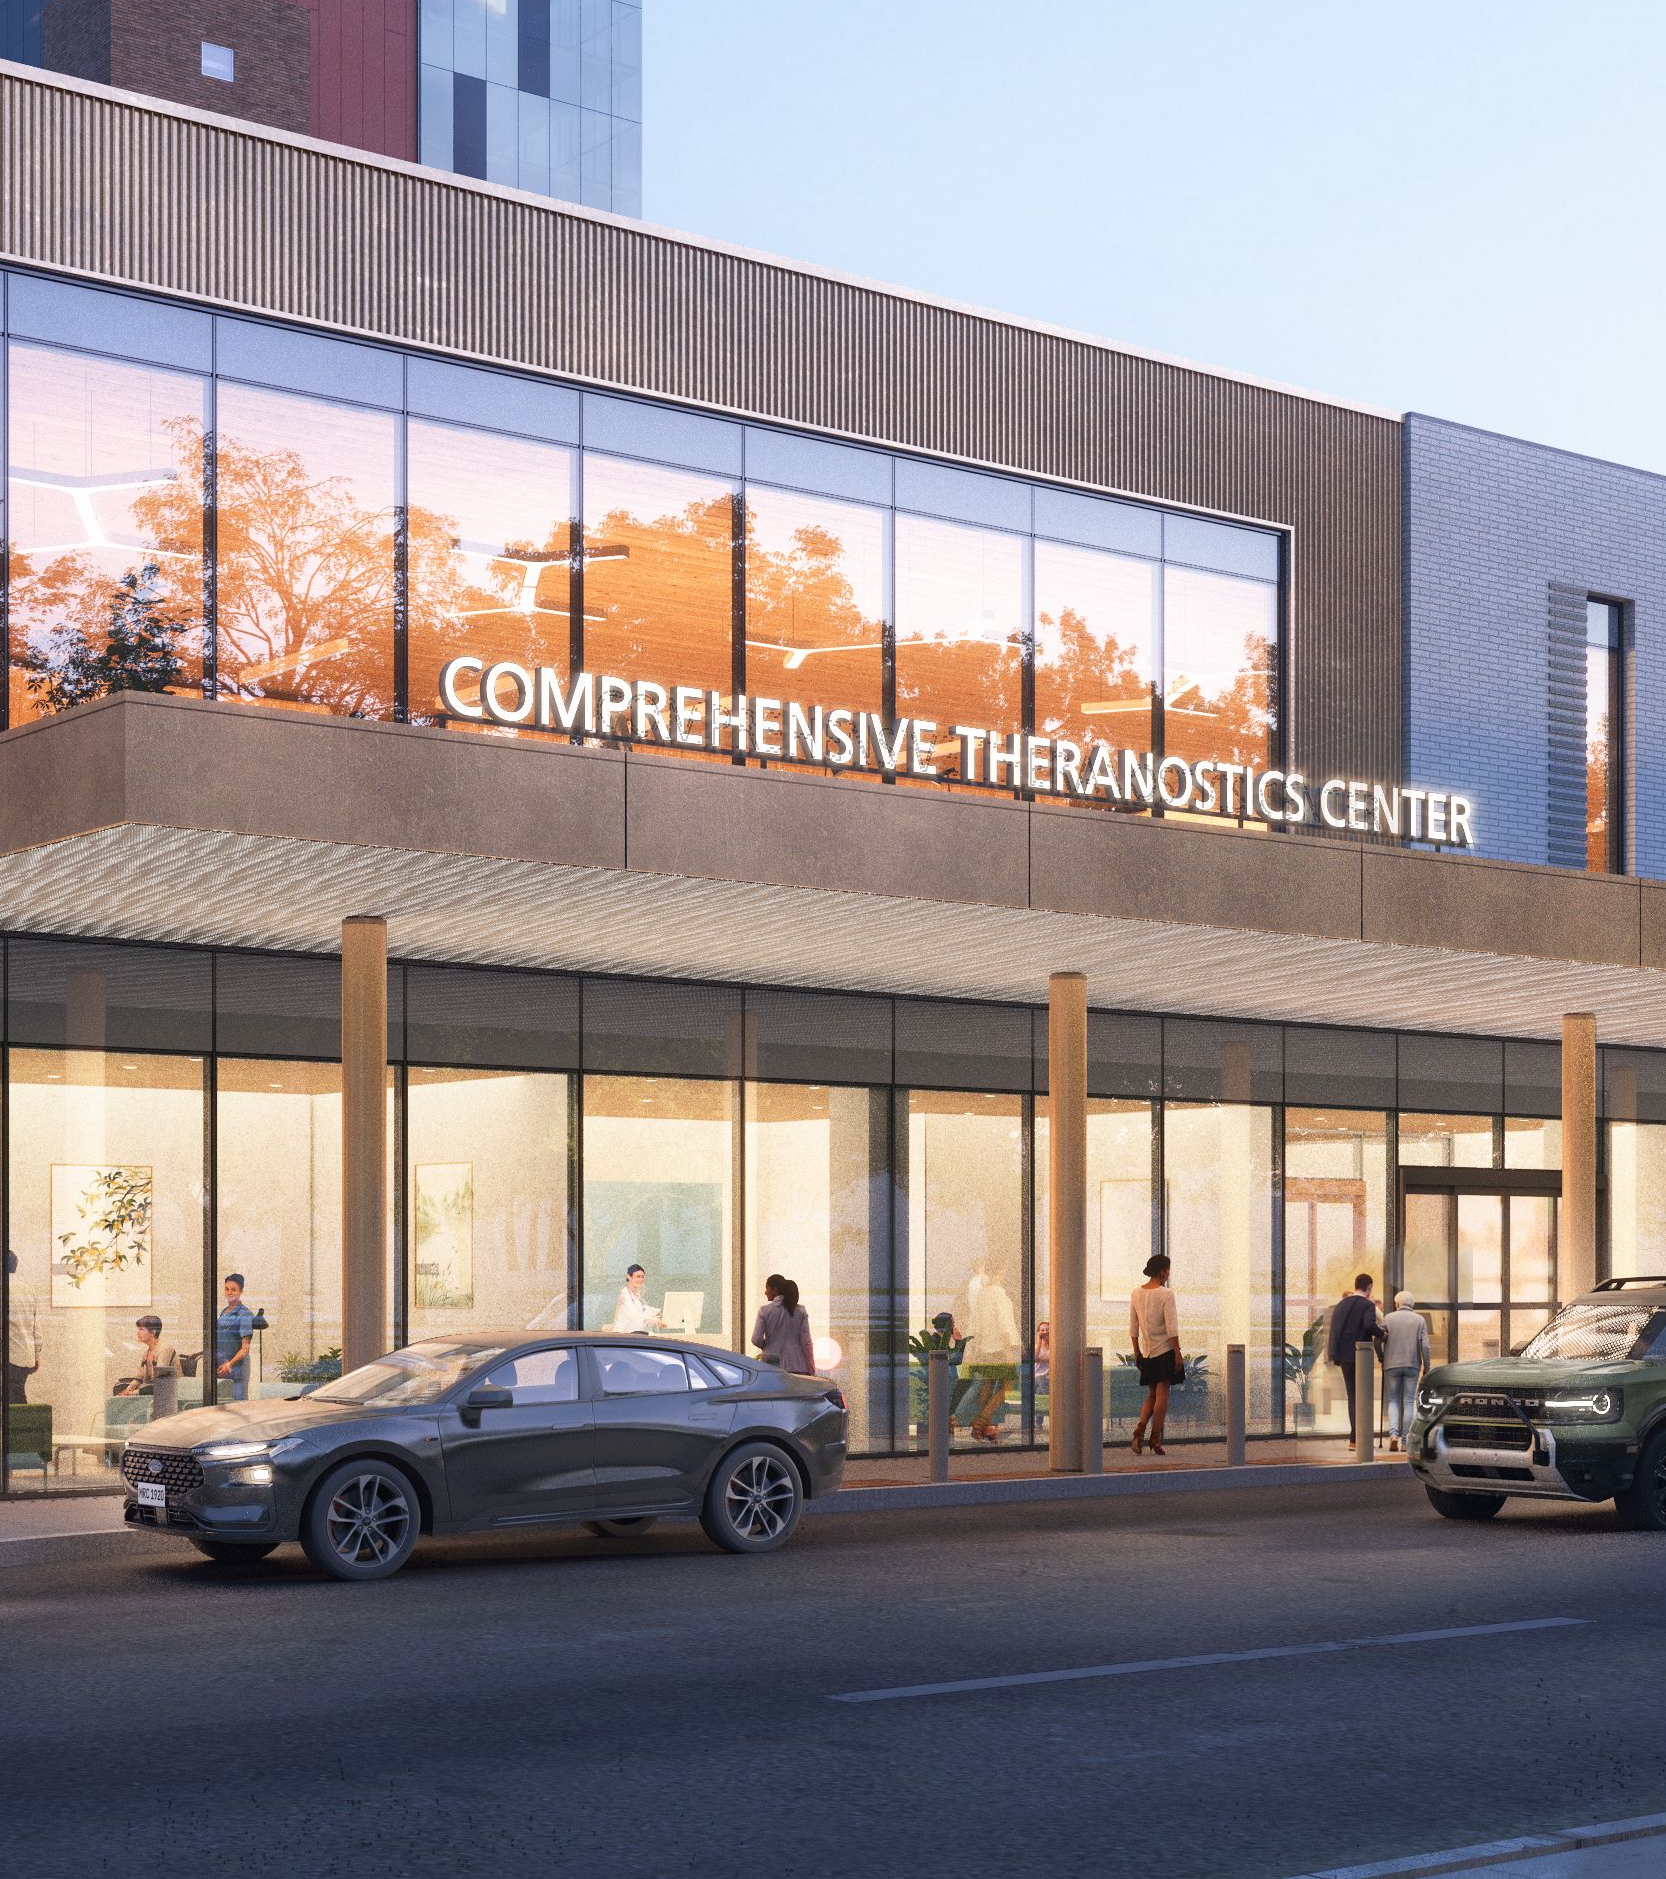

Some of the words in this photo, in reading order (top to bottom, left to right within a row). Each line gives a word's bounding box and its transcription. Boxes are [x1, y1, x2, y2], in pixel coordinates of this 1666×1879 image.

[438, 656, 938, 776] COMPREHENSIVE
[949, 724, 1307, 822] THERANOSTICS
[1318, 779, 1475, 844] CENTER
